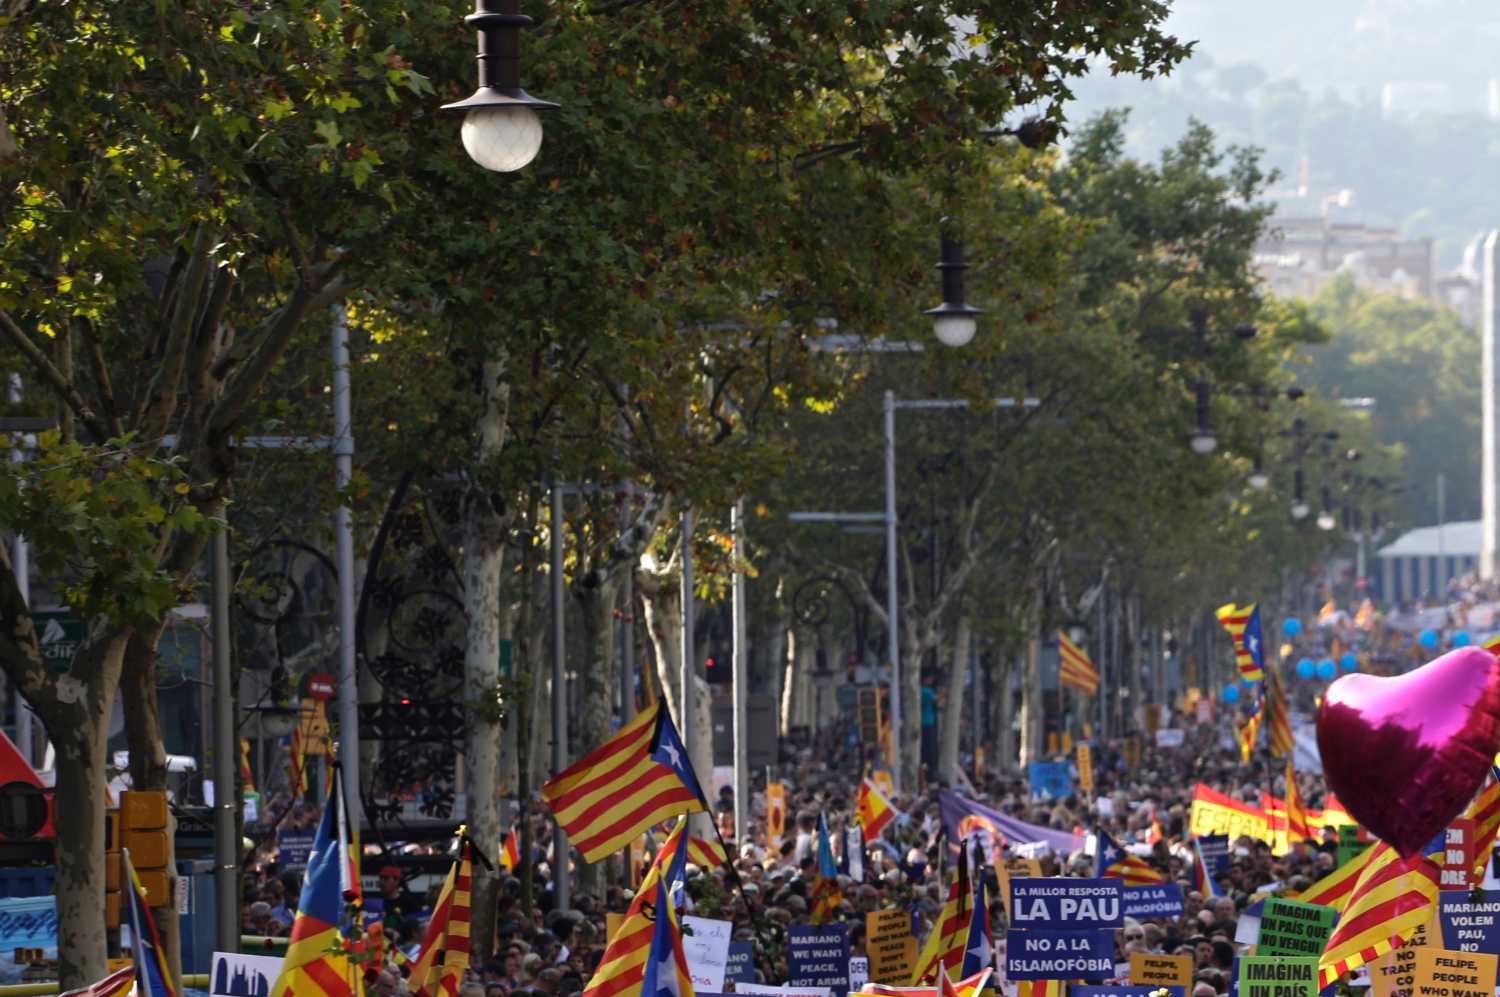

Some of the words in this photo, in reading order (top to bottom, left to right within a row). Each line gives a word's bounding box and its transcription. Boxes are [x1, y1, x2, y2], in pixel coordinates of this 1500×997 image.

[1014, 887, 1026, 896] LA
[1029, 886, 1065, 896] MILLOR
[1068, 887, 1118, 897] RESPOSTA
[1014, 899, 1051, 921] LA
[1060, 897, 1118, 920] PAU
[1443, 903, 1500, 914] MARIANO
[1026, 939, 1050, 952] NO
[1055, 938, 1067, 951] A
[1071, 937, 1090, 950] LA
[1009, 955, 1112, 972] ISLAMOFÒBIA
[1435, 957, 1477, 971] FELIPE,
[1248, 963, 1312, 981] IMAGINA
[1432, 972, 1478, 984] PEOPLE
[1420, 986, 1452, 997] WHO
